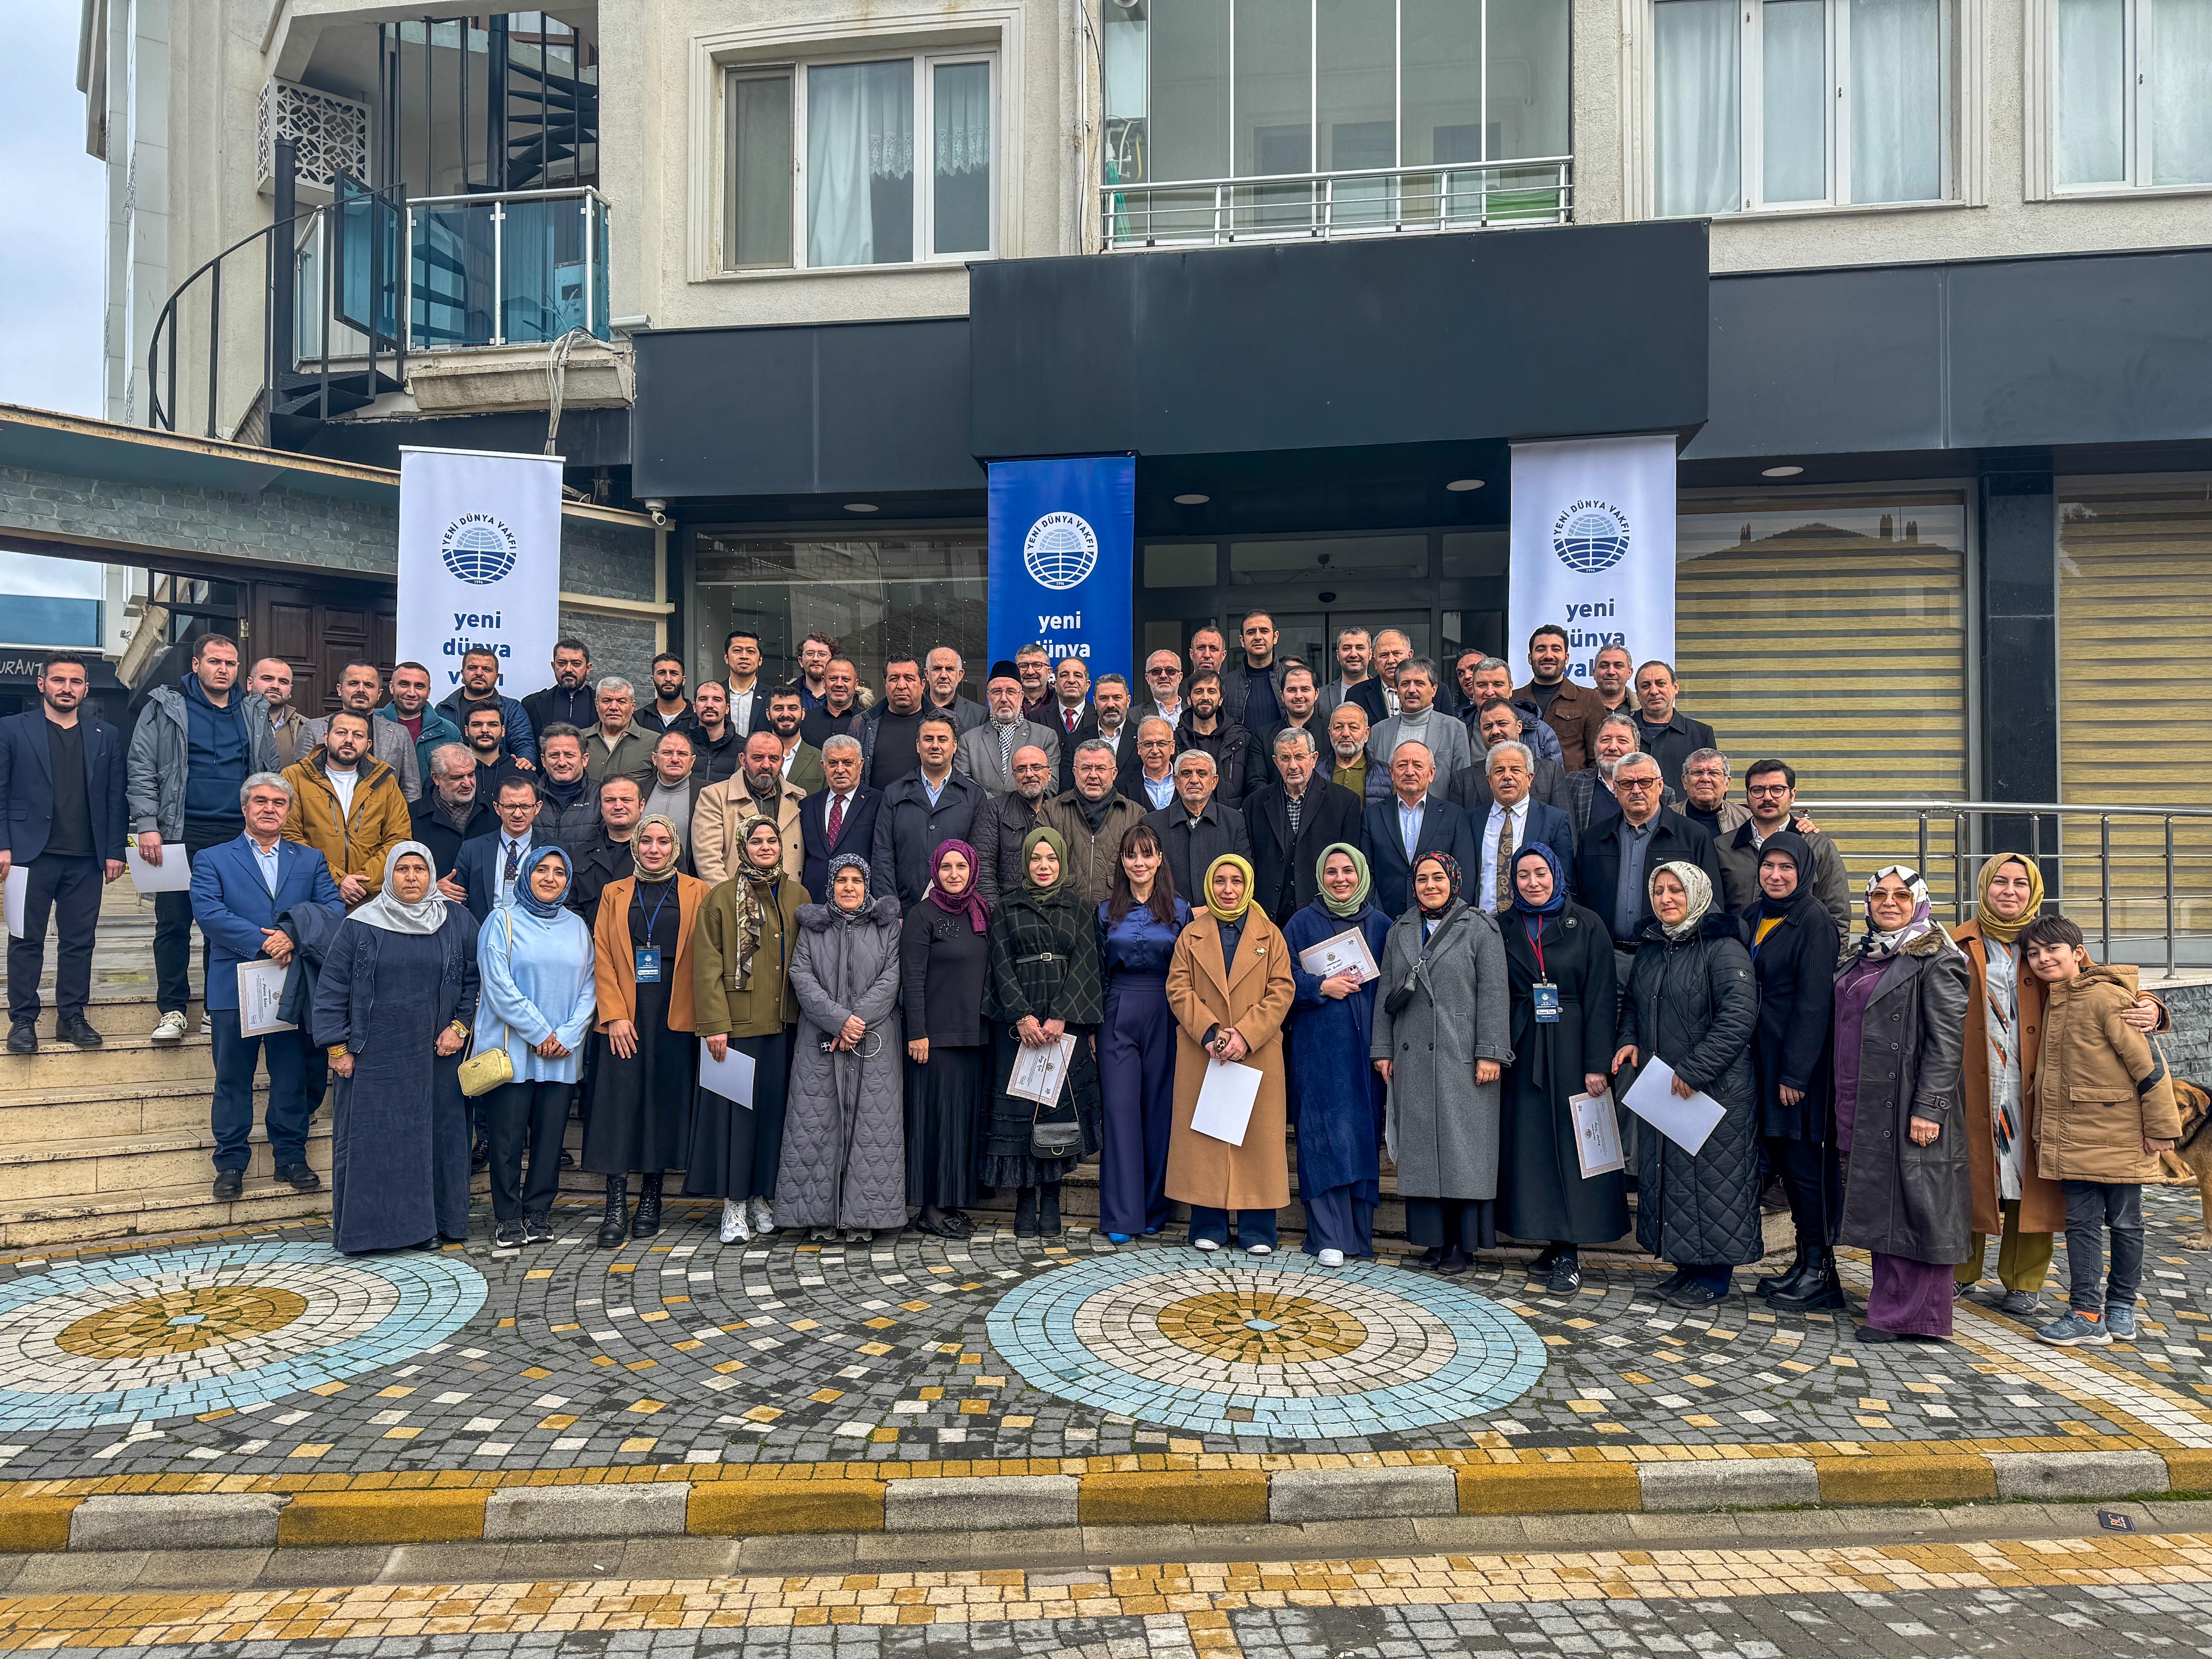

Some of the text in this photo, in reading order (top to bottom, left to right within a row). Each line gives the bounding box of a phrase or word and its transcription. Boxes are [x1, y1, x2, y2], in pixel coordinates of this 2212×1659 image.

[1554, 500, 1630, 535] YENİ DÜNYA VAKFI
[442, 513, 517, 549] YENİ DÜNYA VAKFI
[1027, 515, 1094, 549] YENİ DÜNYA VAKFI
[454, 611, 501, 631] yeni
[1566, 598, 1614, 622] yeni
[1038, 611, 1081, 634] yeni
[1036, 639, 1090, 658] ünya
[1569, 629, 1625, 648] ünya
